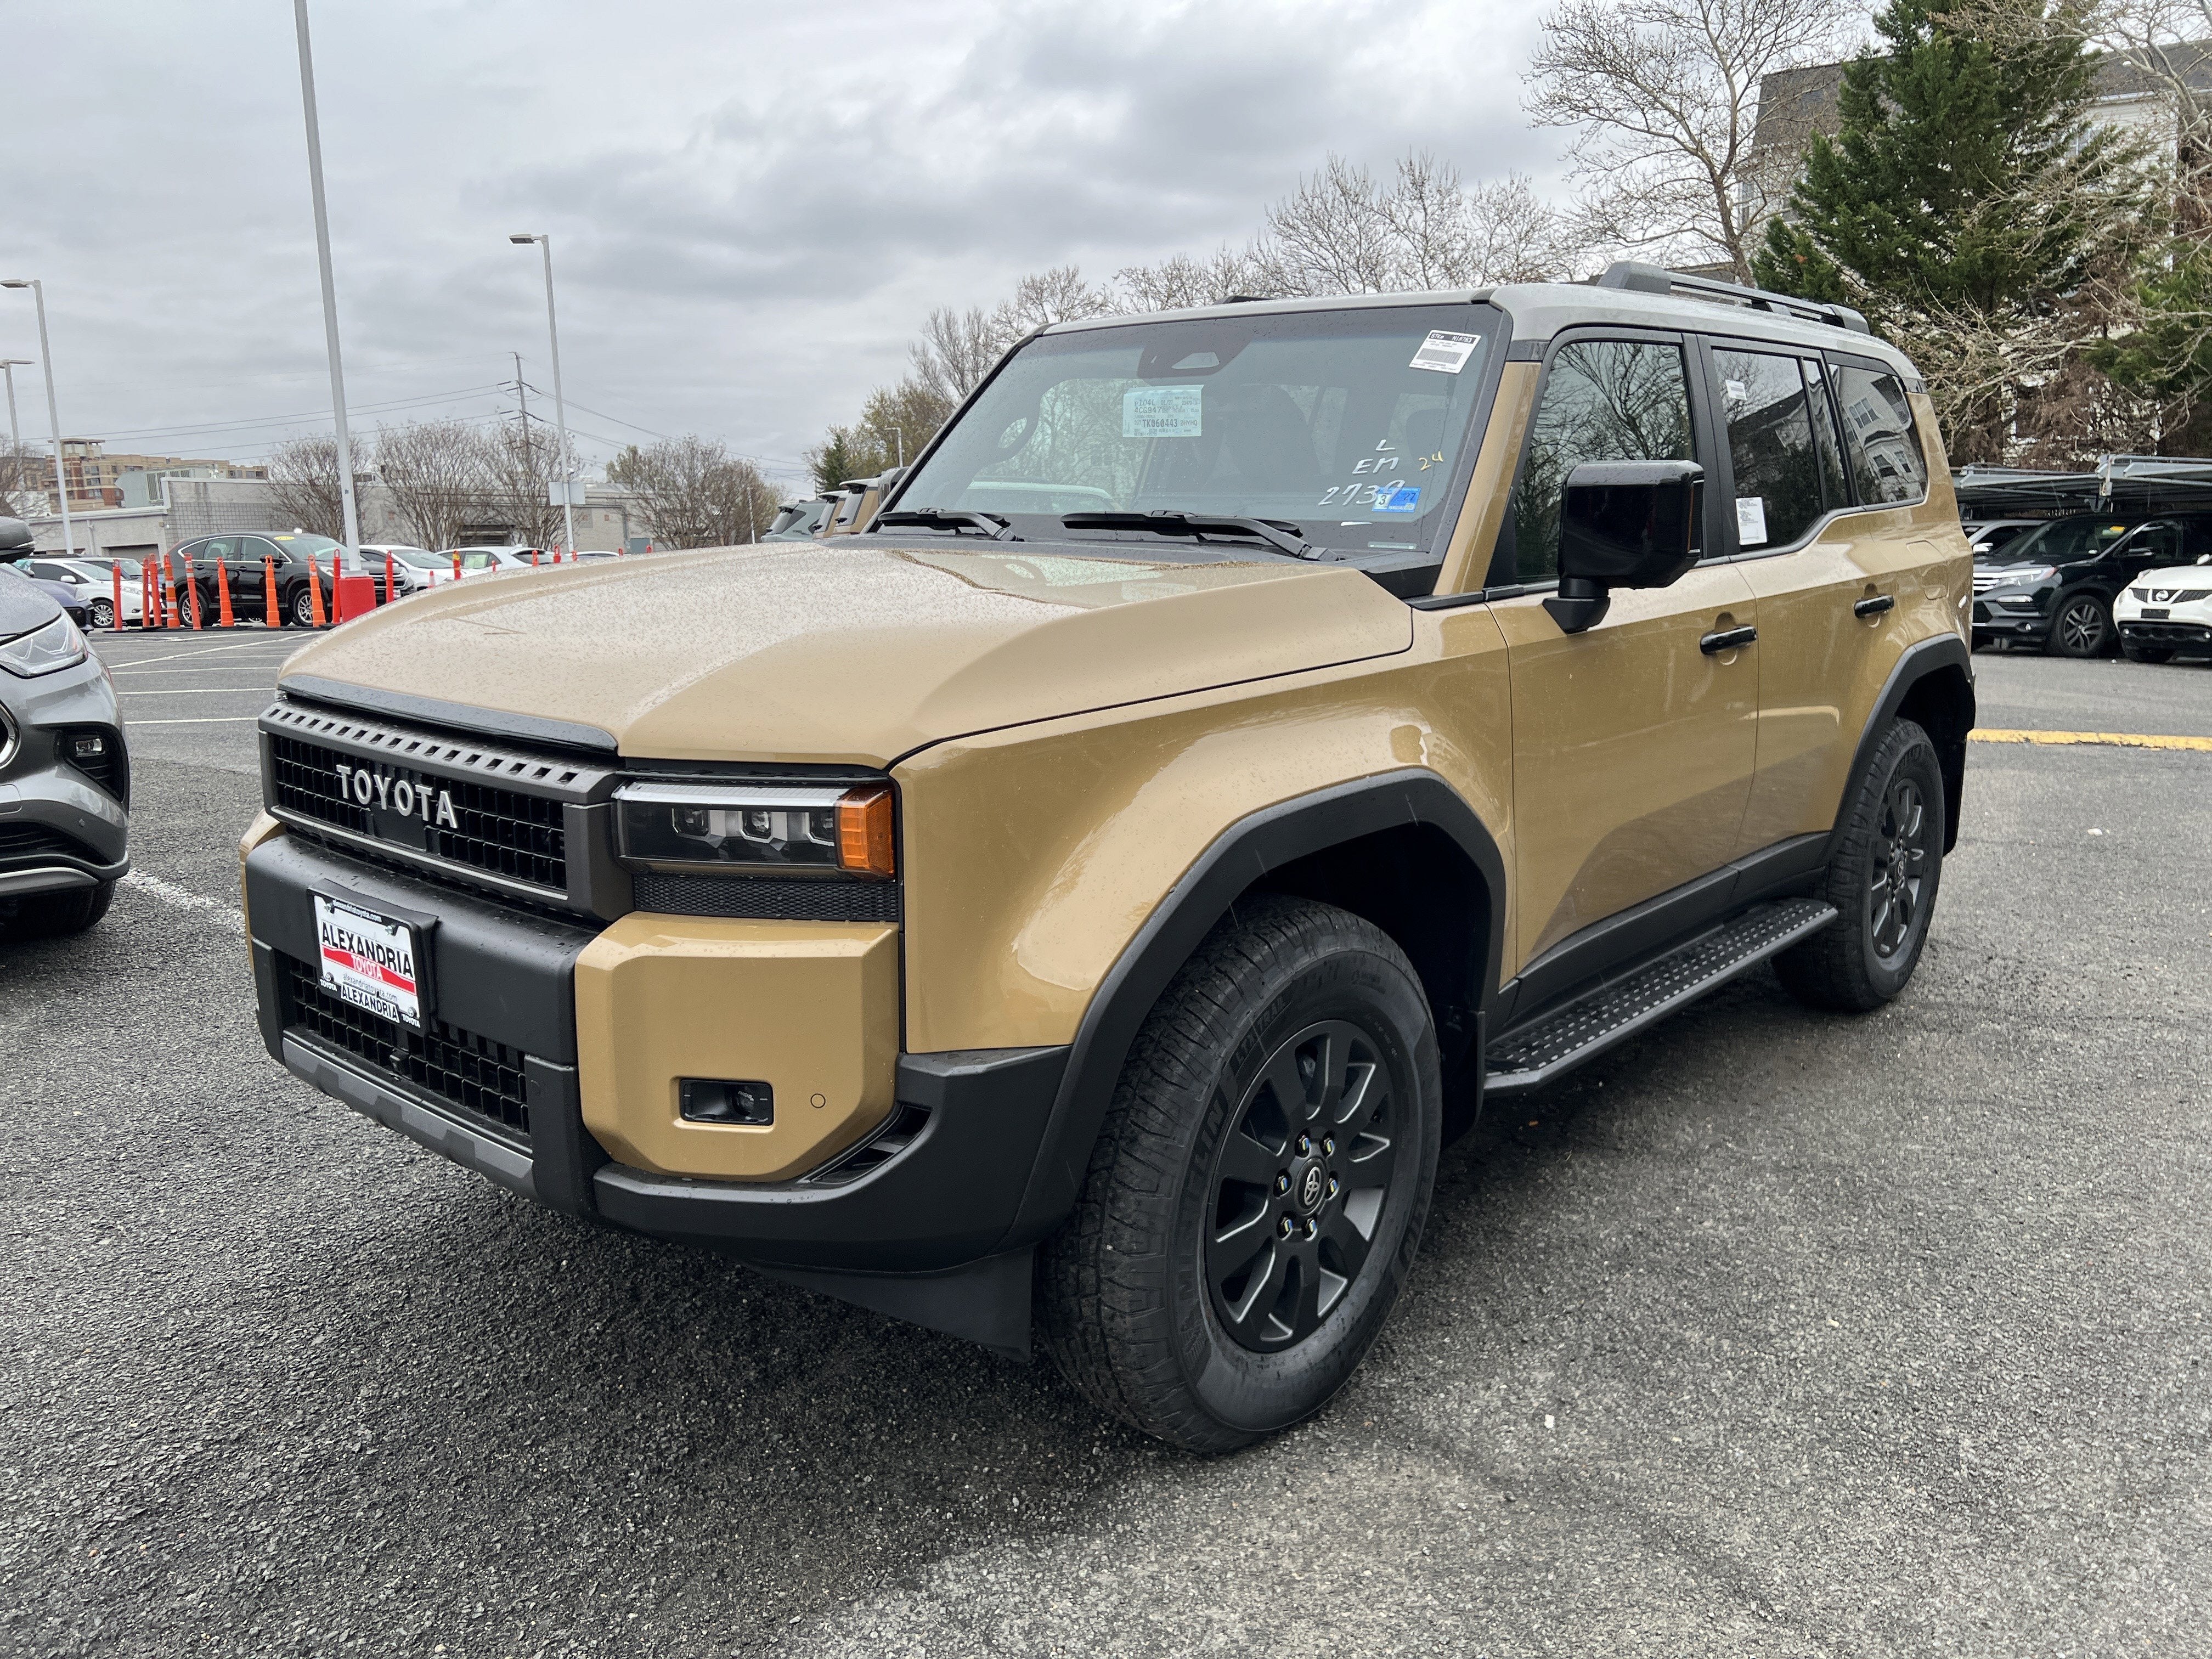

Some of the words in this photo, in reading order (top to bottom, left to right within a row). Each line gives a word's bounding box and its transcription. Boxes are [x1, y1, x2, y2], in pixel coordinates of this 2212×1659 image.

[1379, 494, 1387, 505] 3
[336, 764, 459, 829] TOYOTA
[322, 922, 414, 978] ALEXANDRIA
[351, 955, 384, 980] TOYOTA
[319, 979, 337, 992] TOYOTA
[342, 985, 399, 1021] ALEXANDRIA
[402, 1014, 421, 1028] TOYOTA
